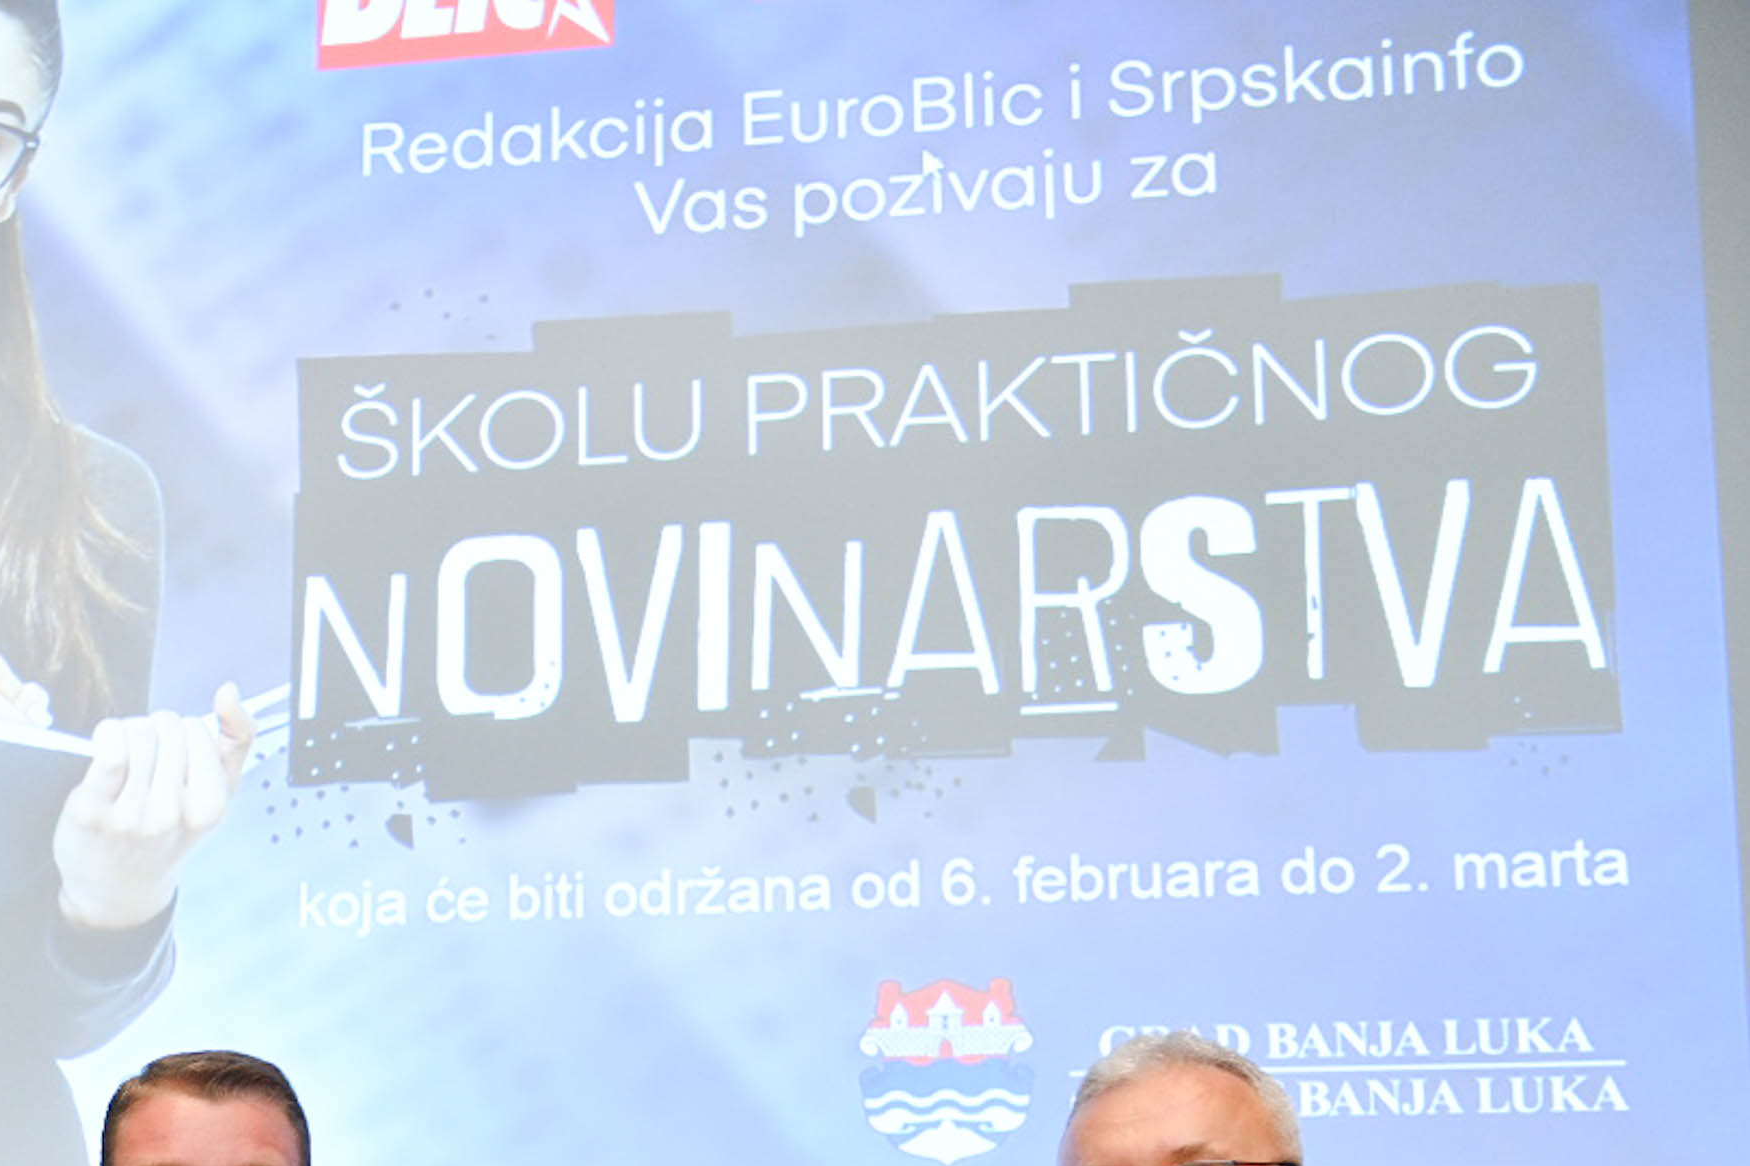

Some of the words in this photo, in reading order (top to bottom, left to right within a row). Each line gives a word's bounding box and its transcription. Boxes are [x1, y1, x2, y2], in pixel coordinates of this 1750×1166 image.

[361, 98, 713, 190] Redakcija
[742, 70, 1044, 146] EuroBlic
[1068, 62, 1081, 120] i
[1107, 31, 1524, 124] Srpskainfo
[634, 177, 768, 235] Vas
[793, 147, 1102, 238] pozivaju
[1130, 151, 1217, 199] za
[337, 379, 702, 479] ŠKOLU
[747, 326, 1537, 456] PRAKTIČNOG
[298, 477, 1608, 722] NOVINARSTVA
[298, 881, 408, 937] koja
[426, 876, 490, 924] će
[509, 871, 585, 921] biti
[604, 866, 832, 918] održana
[851, 859, 921, 909] od
[941, 857, 992, 906] 6.
[1012, 853, 1261, 904] februara
[1280, 845, 1355, 895] do
[1376, 843, 1429, 893] 2.
[1453, 839, 1630, 890] marta
[1266, 1020, 1431, 1060] BANJA
[1443, 1016, 1595, 1056] LUKA
[1298, 1078, 1464, 1118] BANJA
[1477, 1074, 1630, 1115] LUKA
